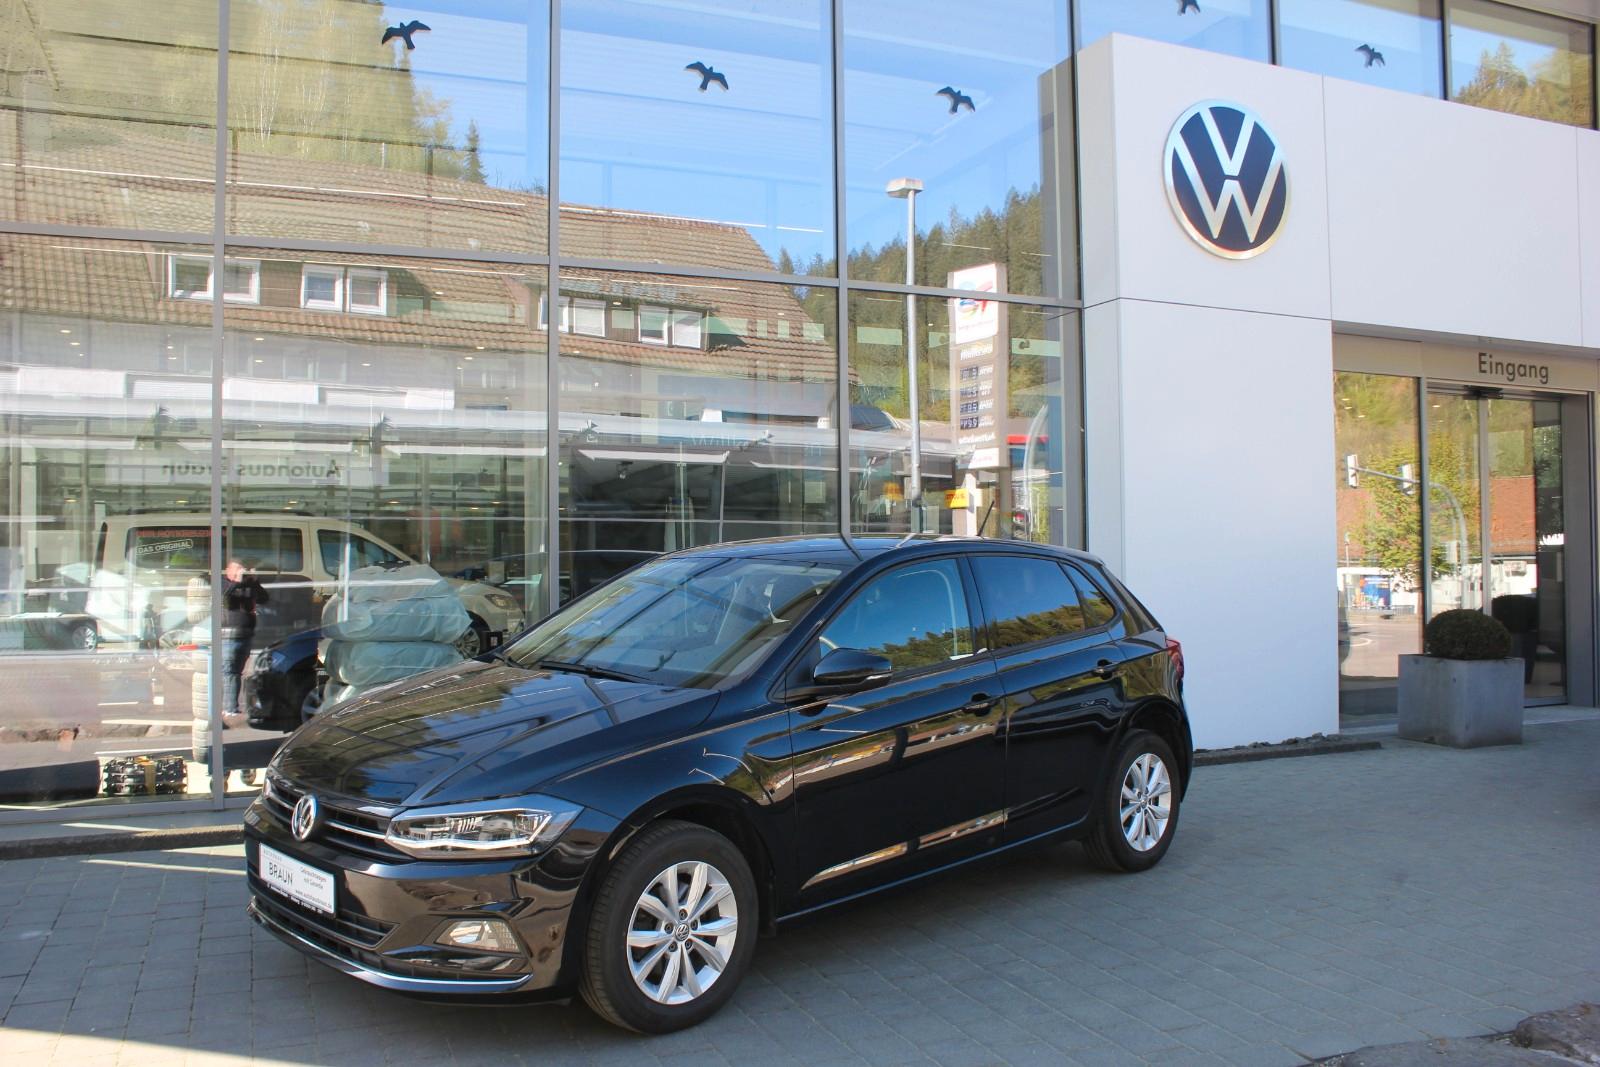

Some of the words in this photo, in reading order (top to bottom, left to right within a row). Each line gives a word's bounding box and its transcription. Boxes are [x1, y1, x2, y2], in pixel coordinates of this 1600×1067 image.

[1165, 100, 1288, 252] VW
[1478, 352, 1549, 384] Eingang
[137, 546, 154, 554] DAS
[155, 541, 191, 551] ORIGINAL
[268, 862, 293, 886] BRAUN
